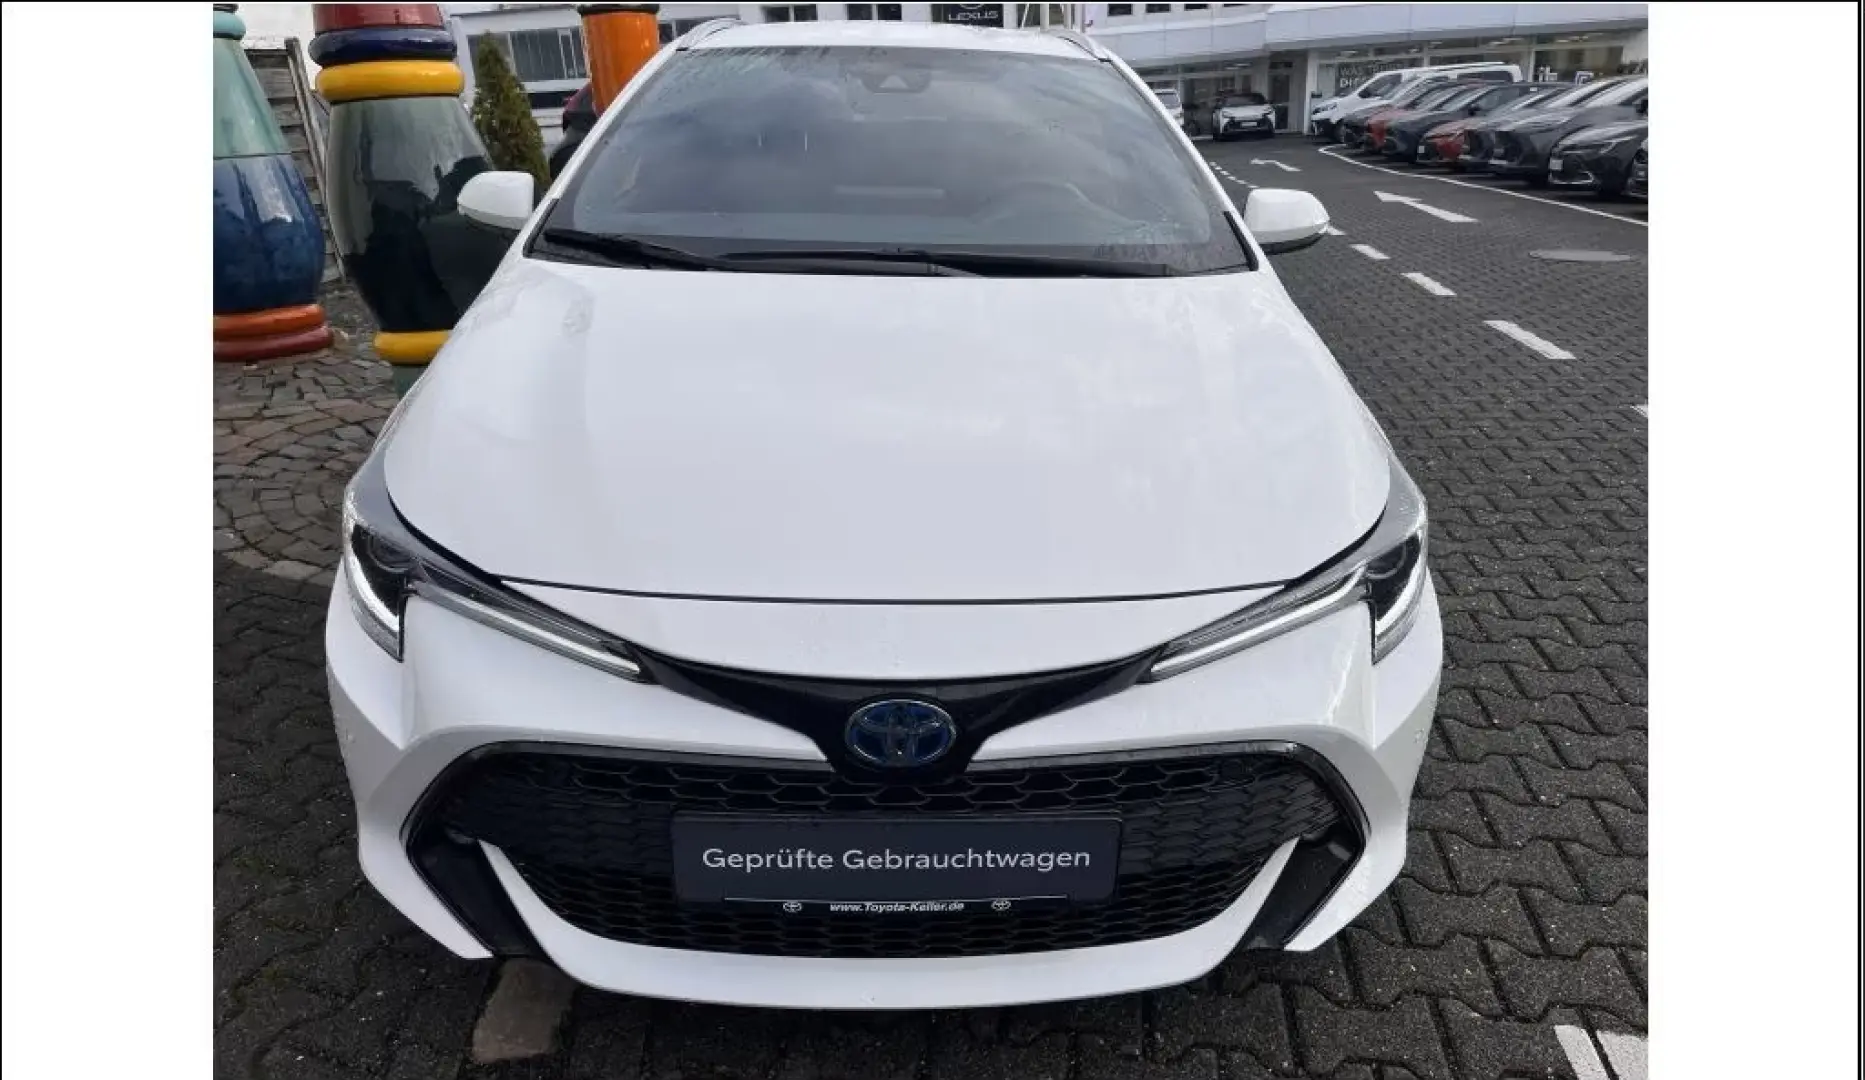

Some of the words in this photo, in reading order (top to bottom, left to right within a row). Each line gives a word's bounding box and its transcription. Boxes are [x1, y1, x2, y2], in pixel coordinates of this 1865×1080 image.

[948, 10, 999, 21] LEXUS
[702, 848, 834, 873] Geprüfte
[842, 848, 1091, 873] Gebrauchtwagen
[829, 901, 965, 913] www.Toyota-Keller.de
